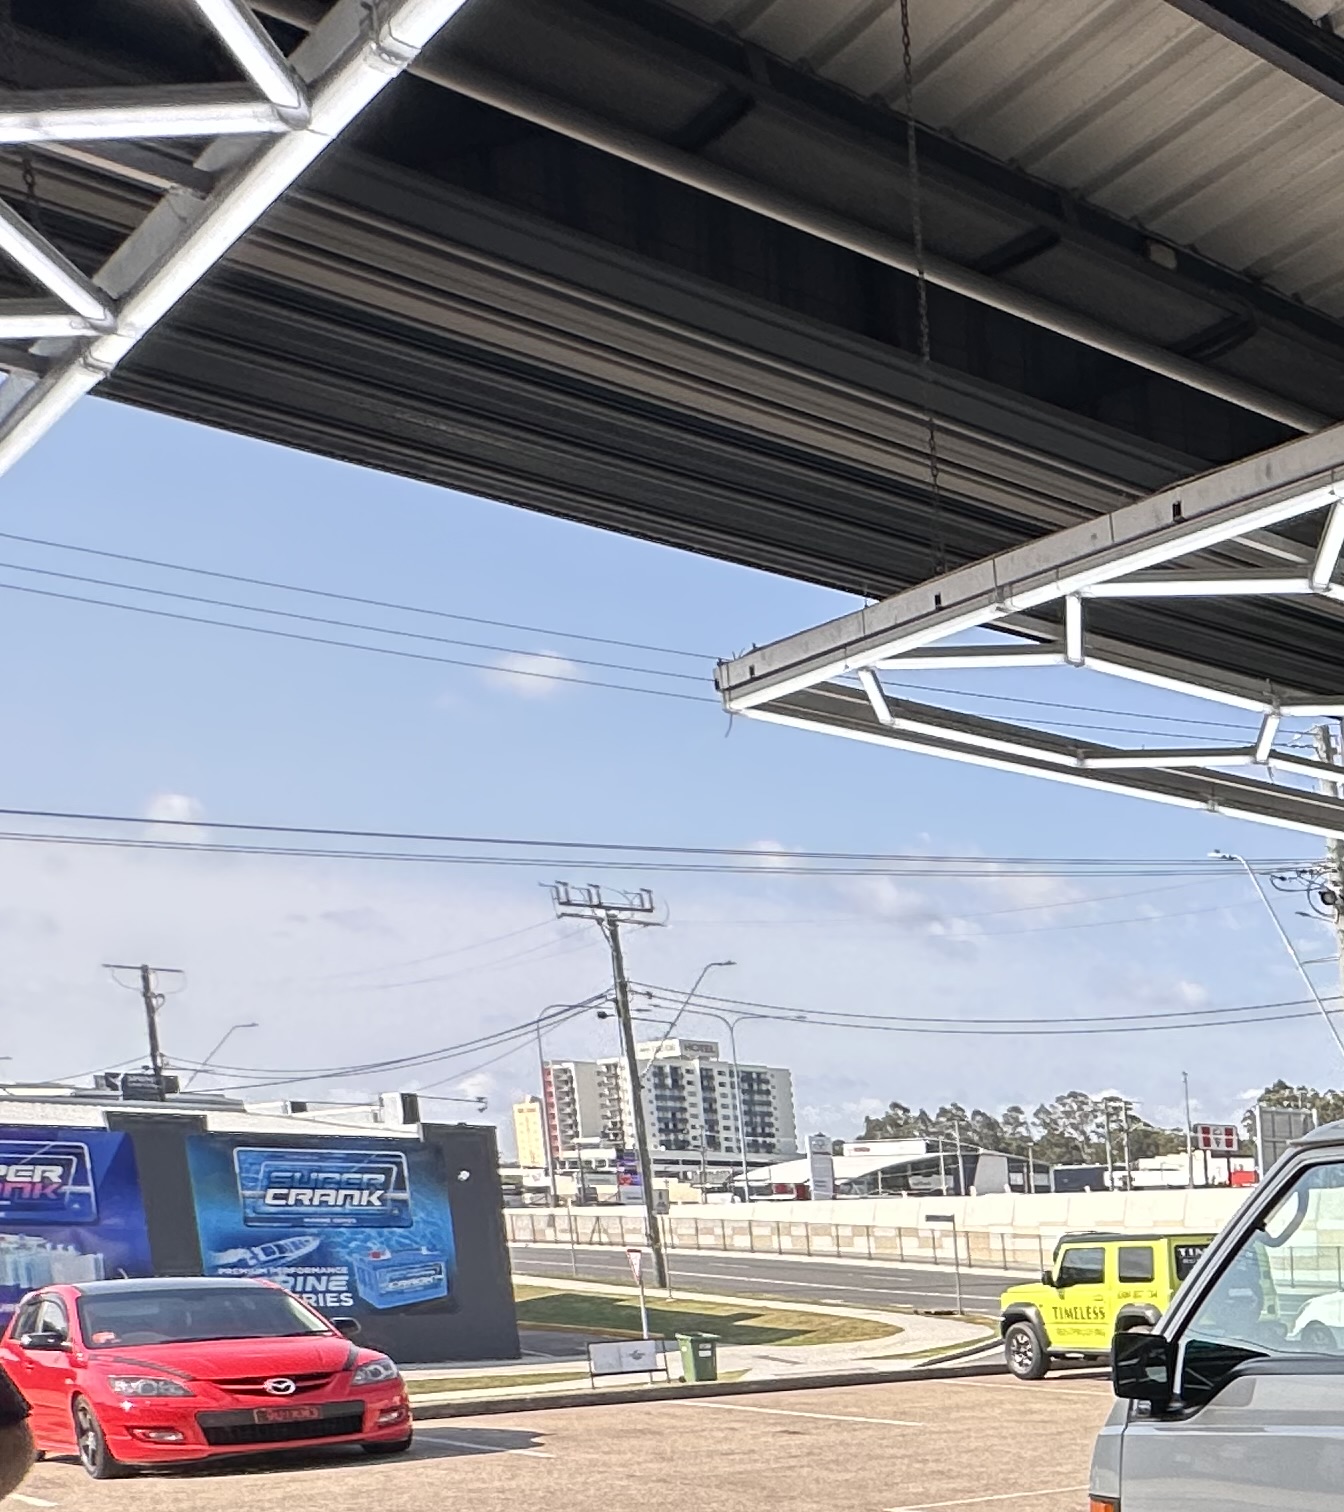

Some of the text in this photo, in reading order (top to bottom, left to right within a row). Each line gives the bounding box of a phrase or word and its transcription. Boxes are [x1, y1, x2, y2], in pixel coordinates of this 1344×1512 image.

[685, 1043, 715, 1053] HOTEL
[270, 1172, 386, 1188] SUPER
[265, 1188, 385, 1206] CRANK
[270, 1266, 349, 1274] PERFORMANCE
[279, 1275, 349, 1291] RINE
[1052, 1306, 1105, 1320] TIMELESS
